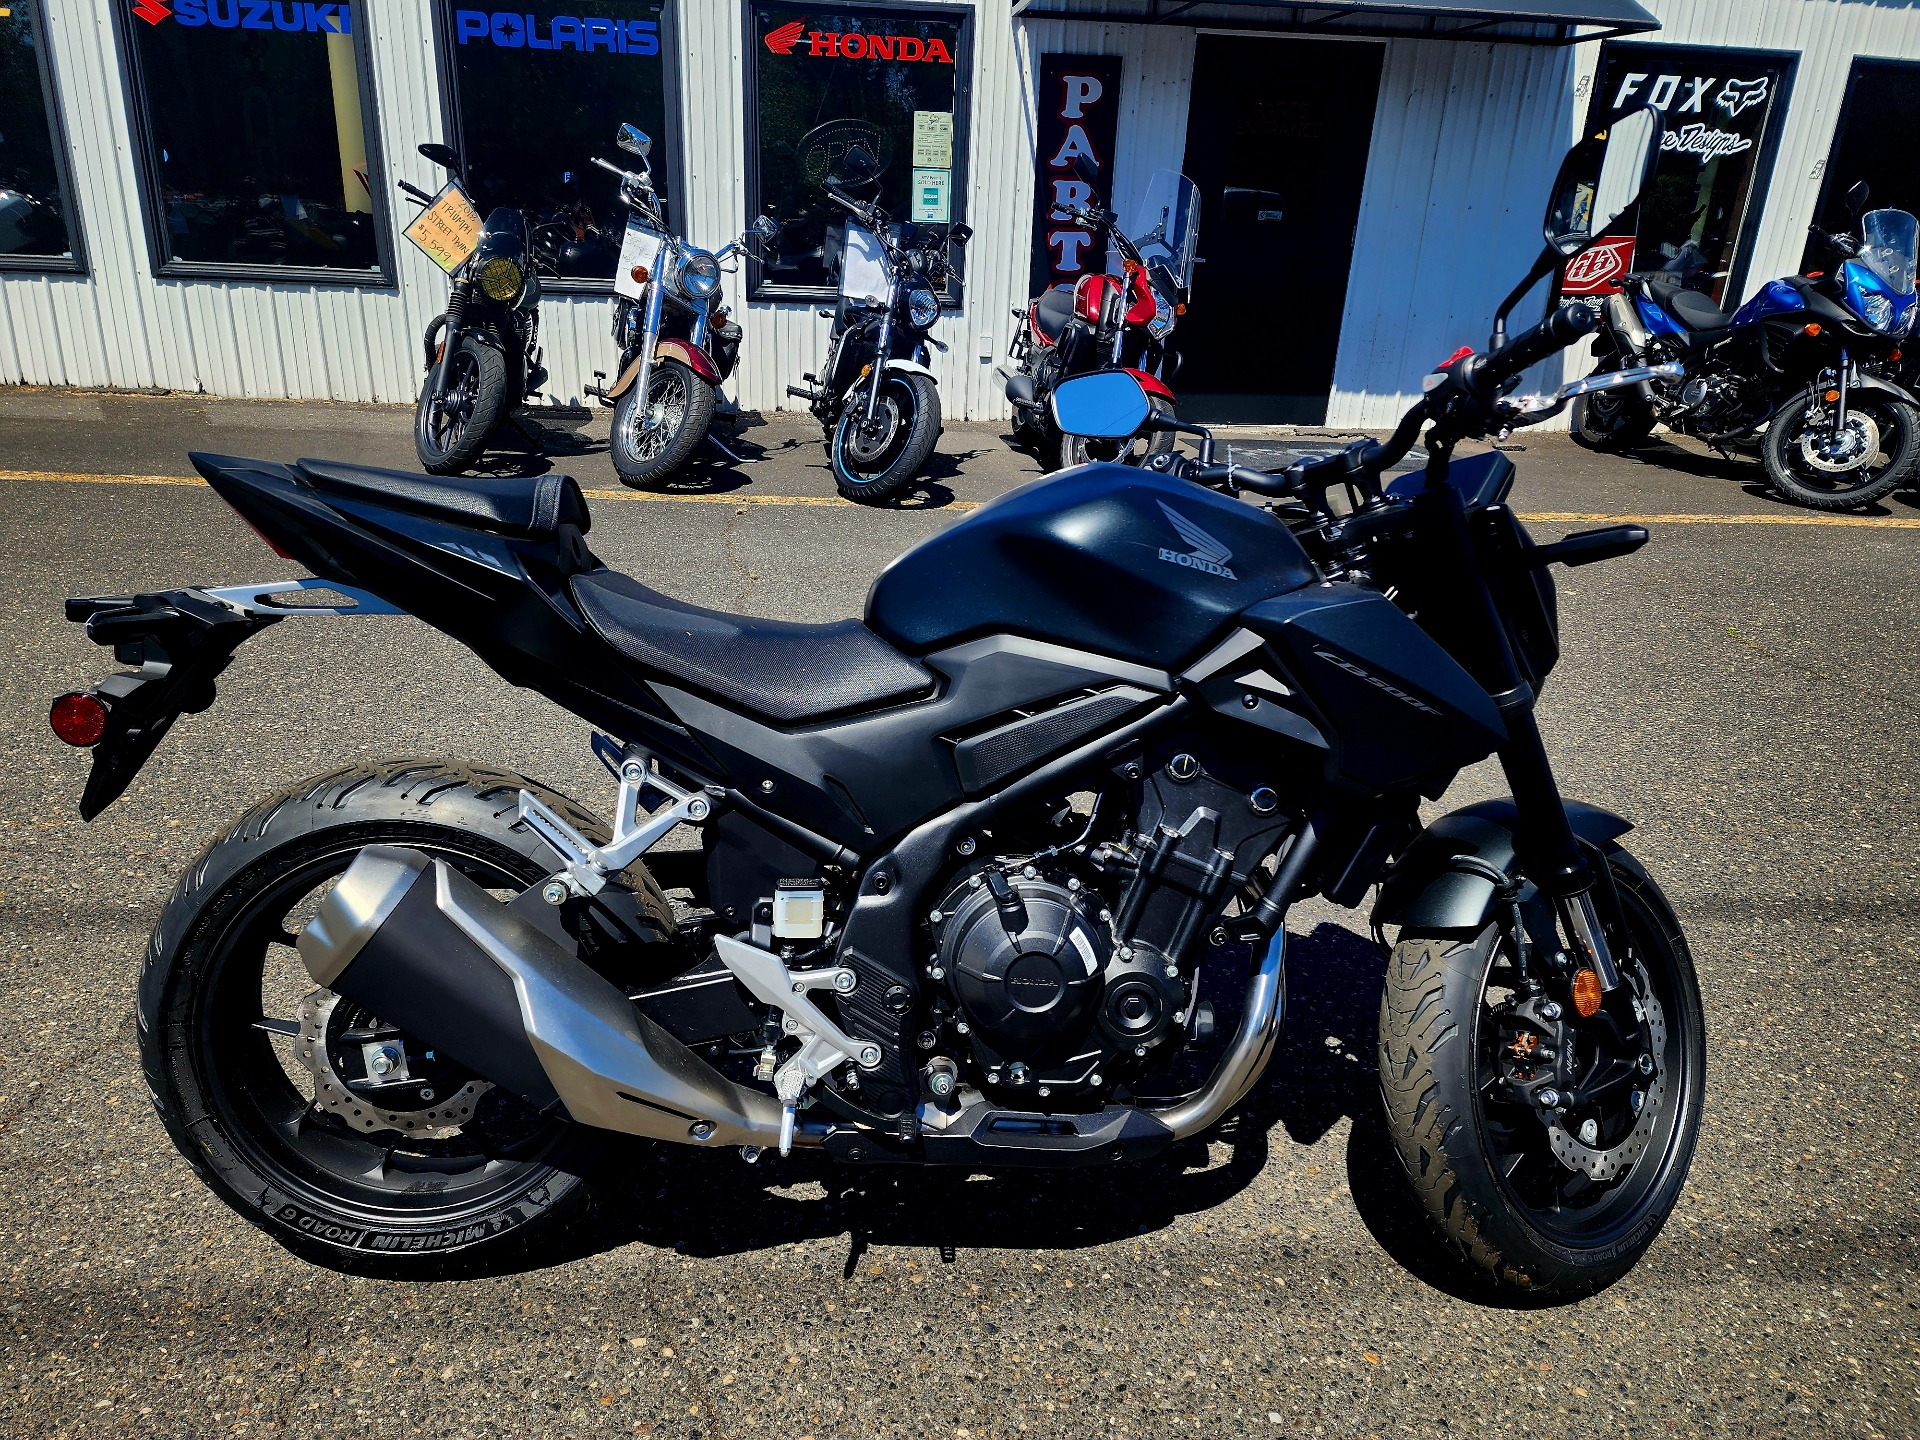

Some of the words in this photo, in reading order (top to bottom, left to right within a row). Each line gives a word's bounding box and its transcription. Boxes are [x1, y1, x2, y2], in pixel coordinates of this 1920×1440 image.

[174, 0, 352, 34] SUZUKI
[456, 10, 659, 56] POLARIS
[808, 31, 954, 63] HONDA
[1613, 73, 1716, 113] FOX
[1050, 75, 1103, 291] PART
[427, 210, 454, 236] STREET
[451, 233, 470, 254] TWIN
[441, 201, 473, 235] TRIUMPH
[1157, 547, 1238, 581] HONDA
[1010, 976, 1059, 988] HONDA
[281, 1206, 296, 1220] 6
[297, 1214, 353, 1243] ROAD
[371, 1222, 487, 1251] MICHELIN
